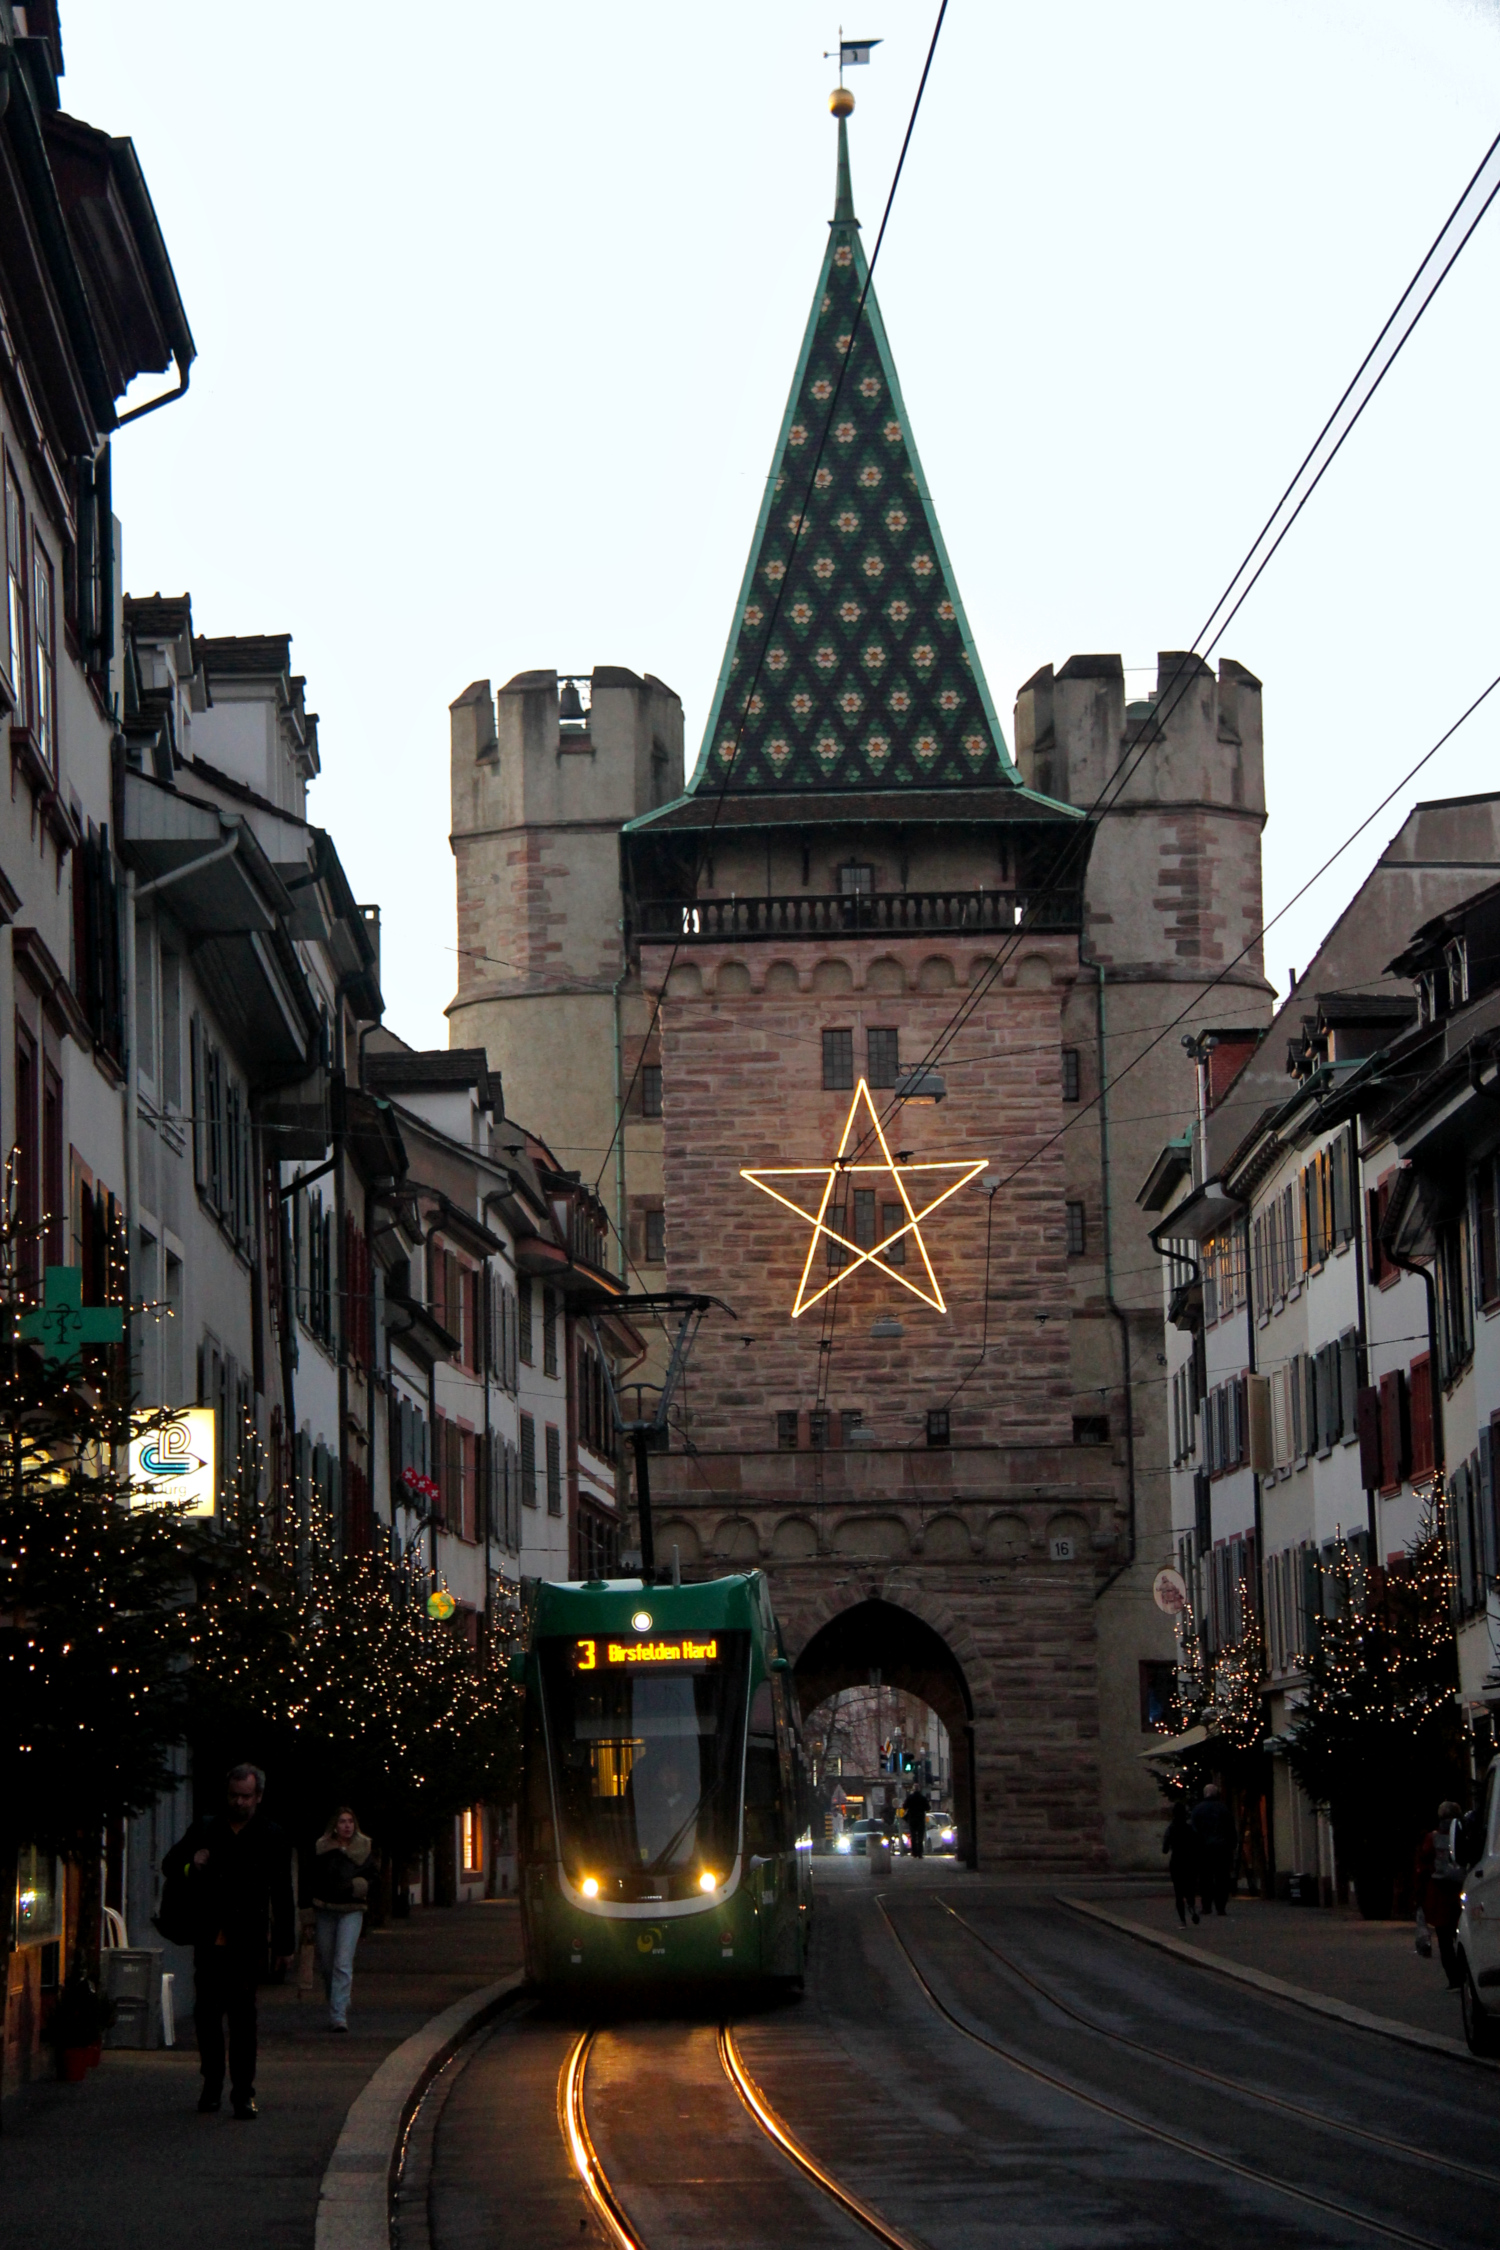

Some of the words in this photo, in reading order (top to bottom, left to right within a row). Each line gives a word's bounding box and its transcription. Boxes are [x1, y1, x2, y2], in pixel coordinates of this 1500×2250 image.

[1055, 1542, 1069, 1556] 16
[577, 1640, 596, 1669] 3
[608, 1642, 681, 1662] Birsfelden
[682, 1640, 717, 1659] Hard
